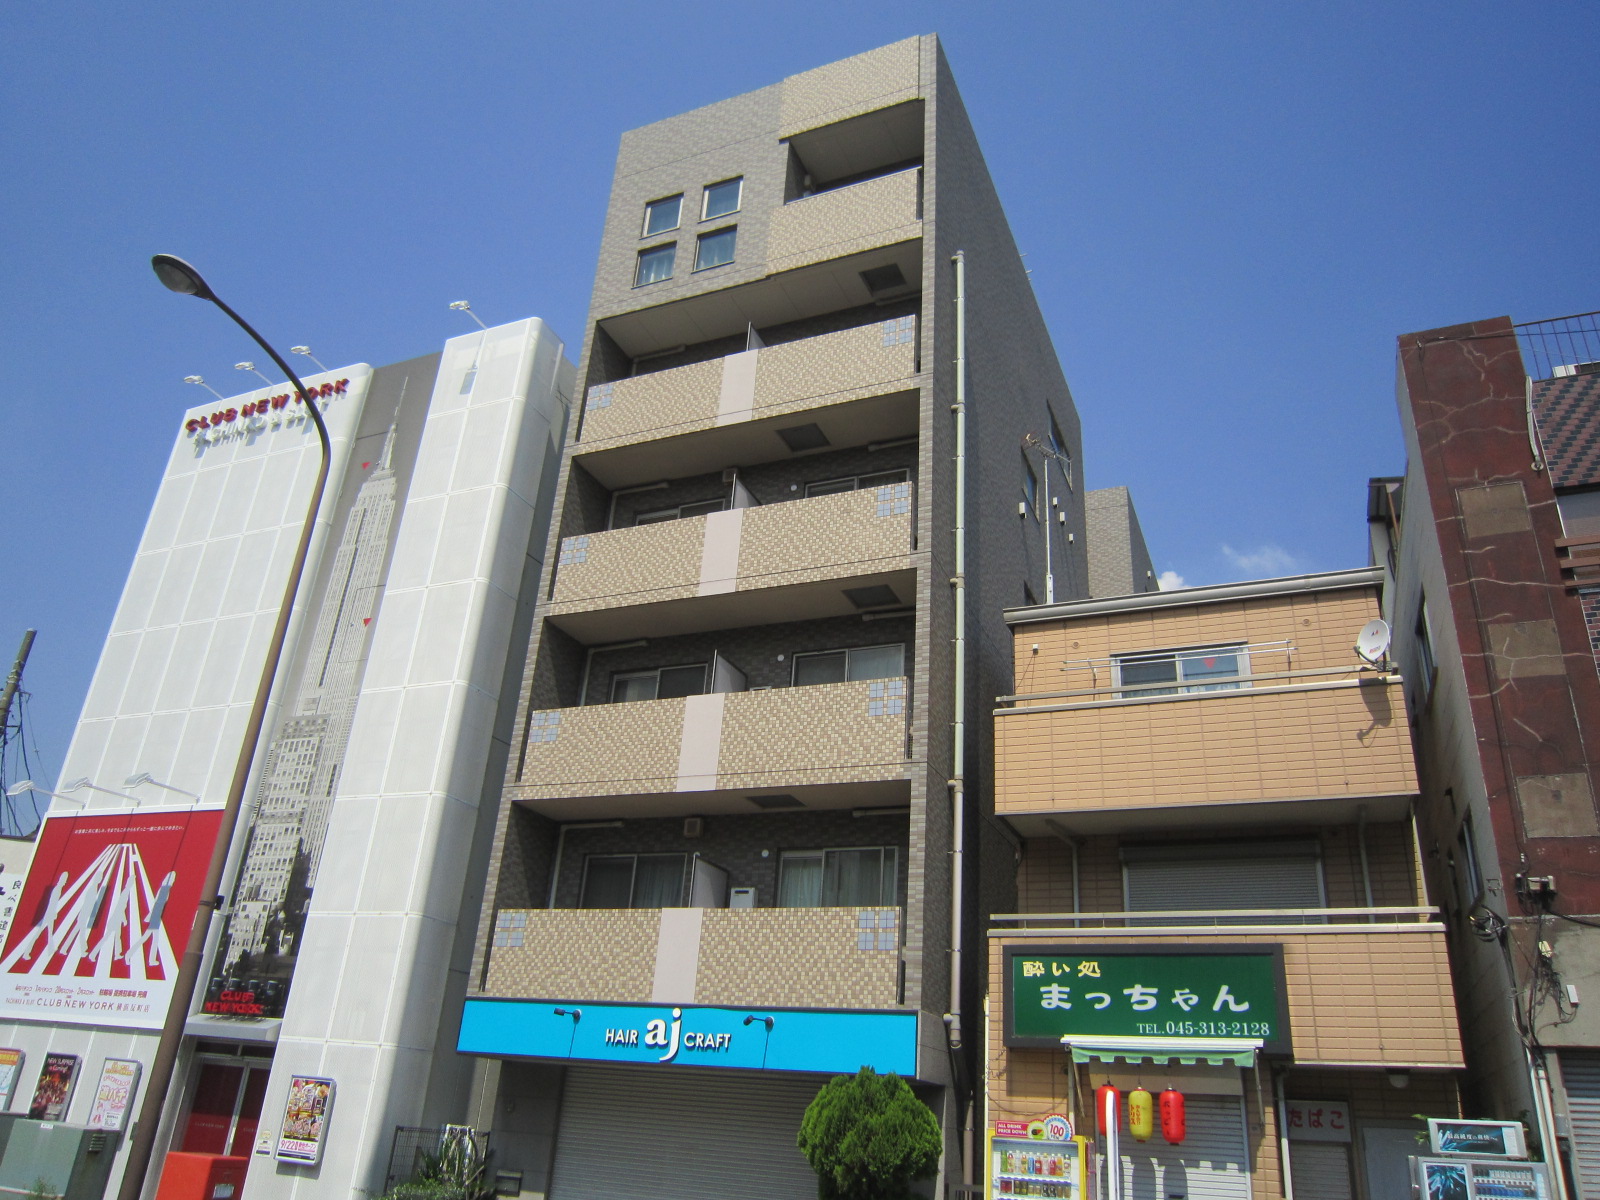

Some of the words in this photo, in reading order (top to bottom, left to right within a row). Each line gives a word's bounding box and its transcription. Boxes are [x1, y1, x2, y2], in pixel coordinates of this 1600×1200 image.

[186, 407, 238, 432] CLUB
[241, 393, 290, 418] NEW
[294, 378, 350, 404] YORK
[1022, 961, 1101, 977] 酔い処
[36, 998, 62, 1007] CLUB
[64, 999, 87, 1009] NEW
[89, 1001, 114, 1011] YORK
[221, 990, 255, 1002] CLUB
[1039, 983, 1250, 1012] まっちゃん
[605, 1028, 639, 1044] HAIR
[644, 1007, 681, 1061] aj
[684, 1032, 731, 1048] CRAFT
[1288, 1107, 1345, 1130] たばこ
[1050, 1124, 1064, 1136] 100
